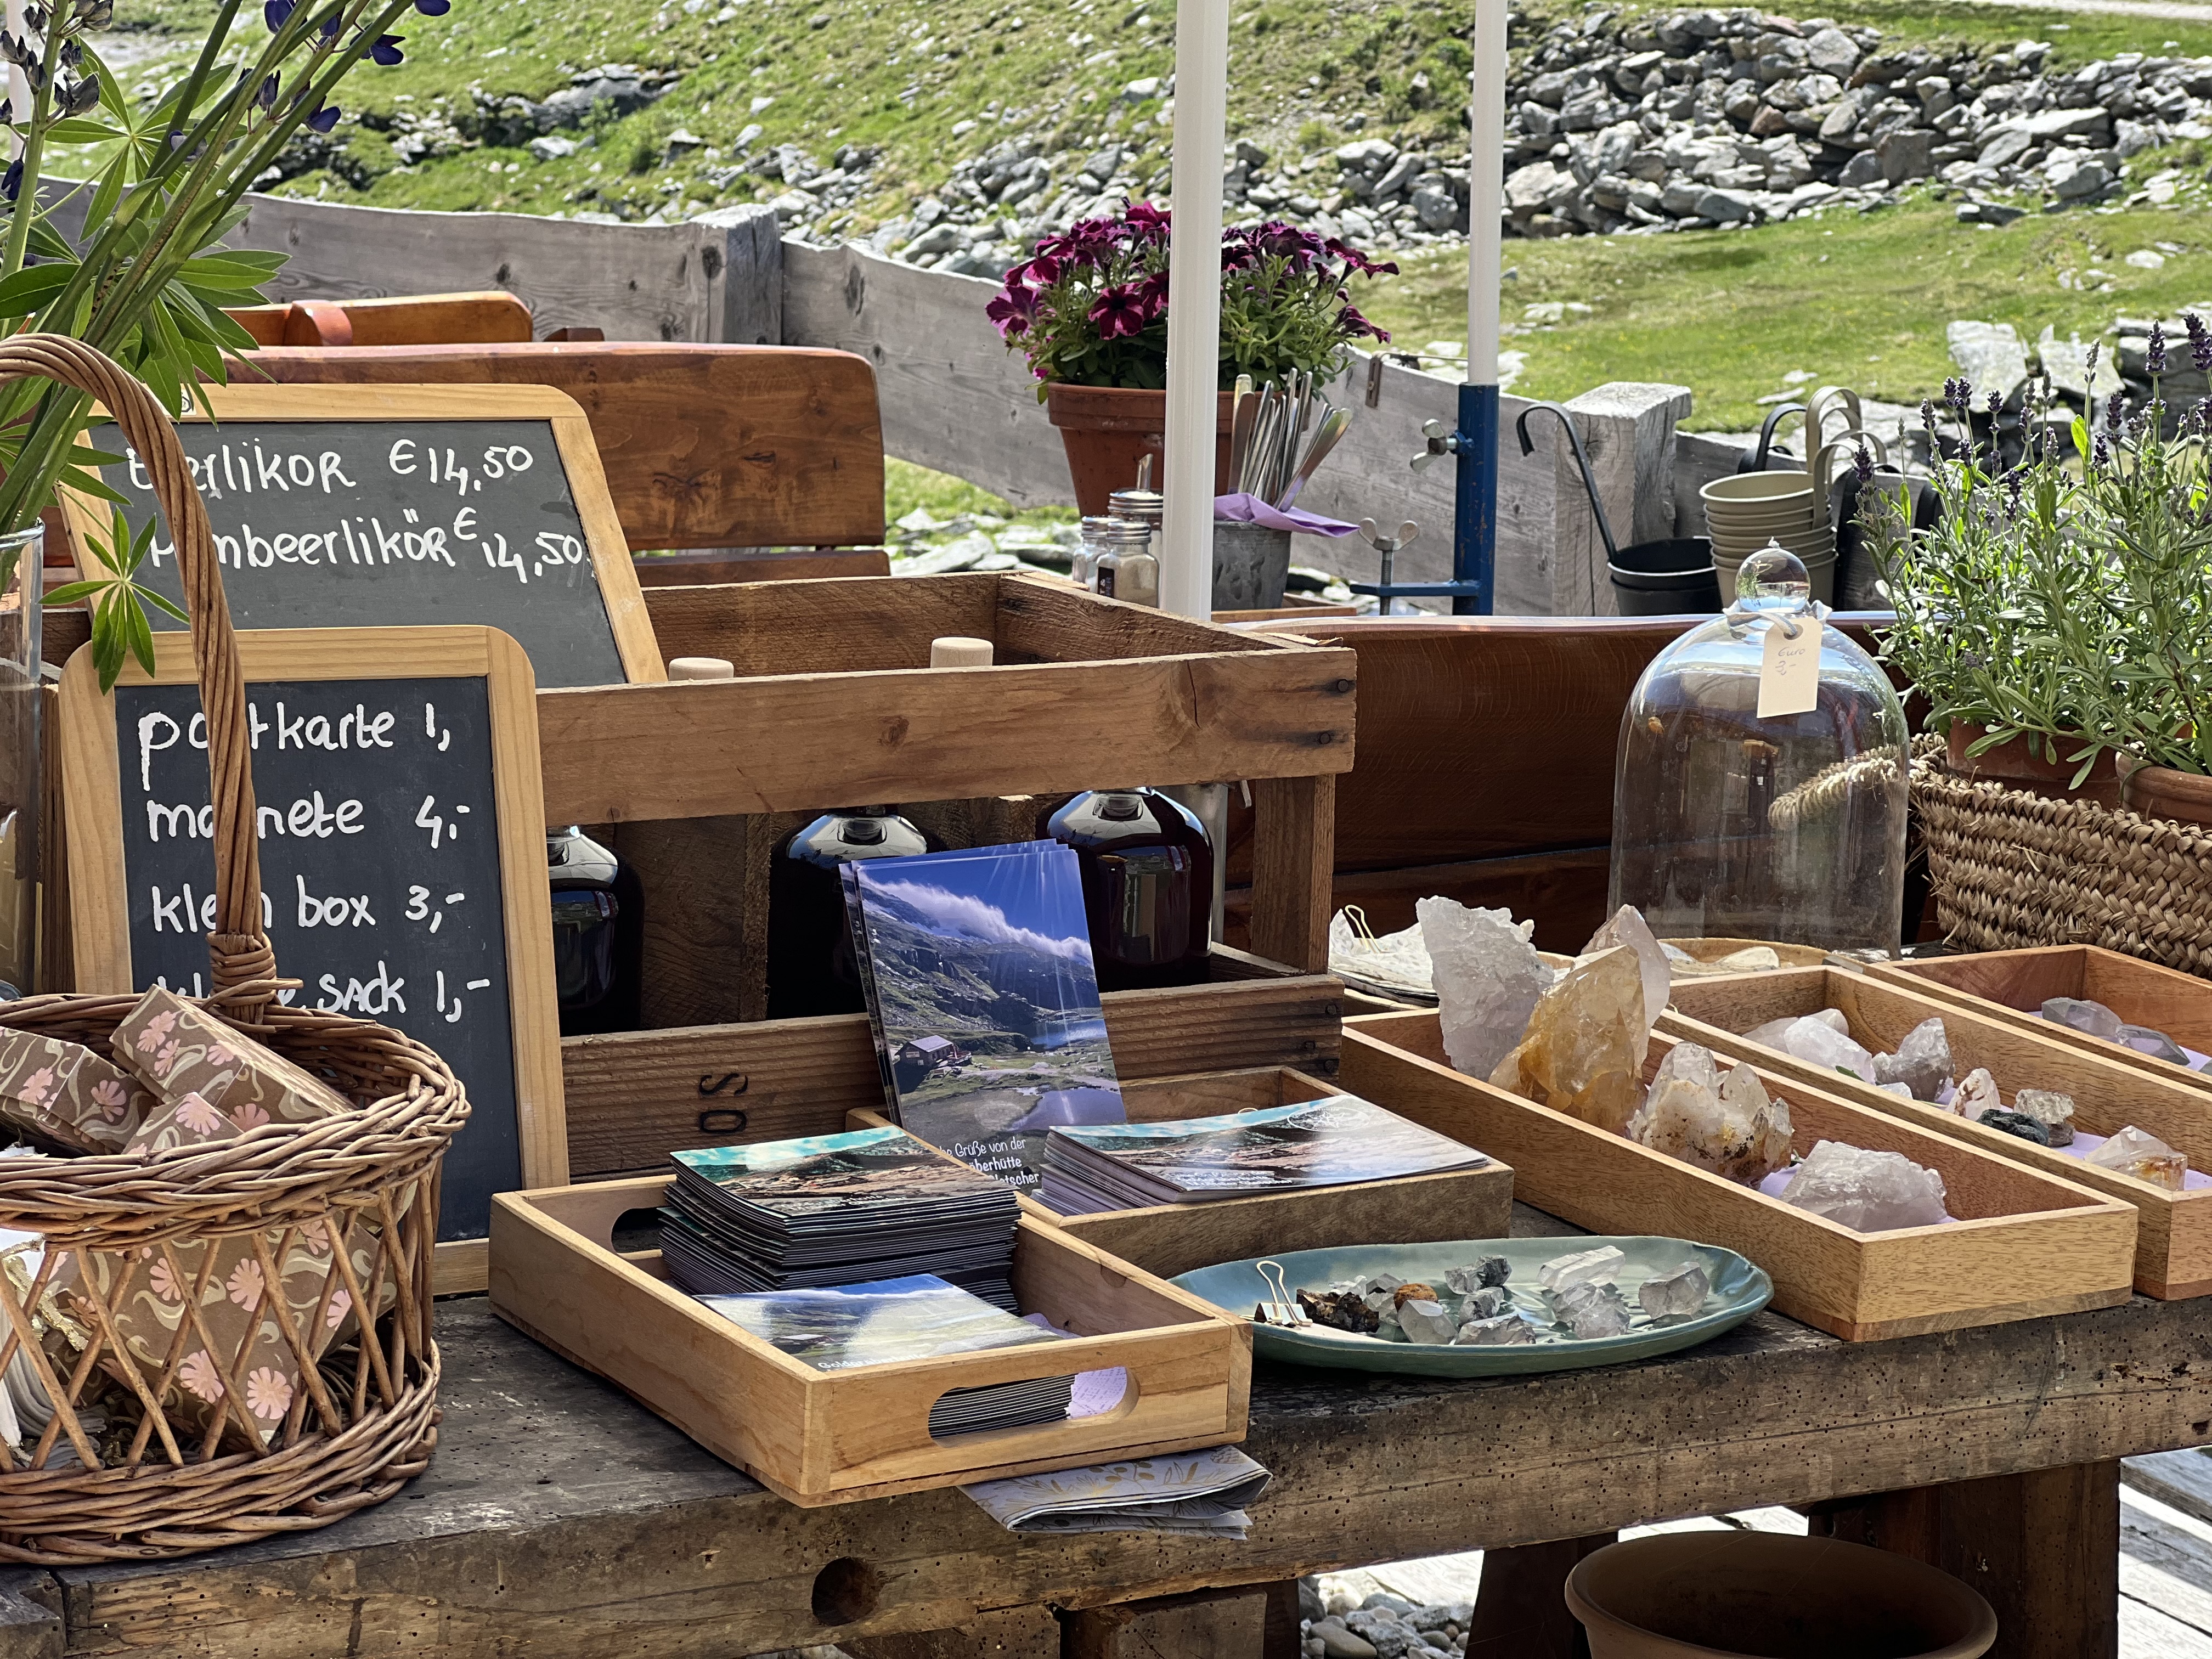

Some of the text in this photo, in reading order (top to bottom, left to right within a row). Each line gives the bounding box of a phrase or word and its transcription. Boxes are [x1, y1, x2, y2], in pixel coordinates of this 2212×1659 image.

[1778, 646, 1805, 657] Euro
[138, 702, 395, 791] potkarte
[146, 791, 364, 842] manete
[151, 874, 465, 933] klen box 3,-
[955, 1141, 987, 1158] Grüße
[989, 1142, 1008, 1153] von
[1010, 1136, 1026, 1150] der
